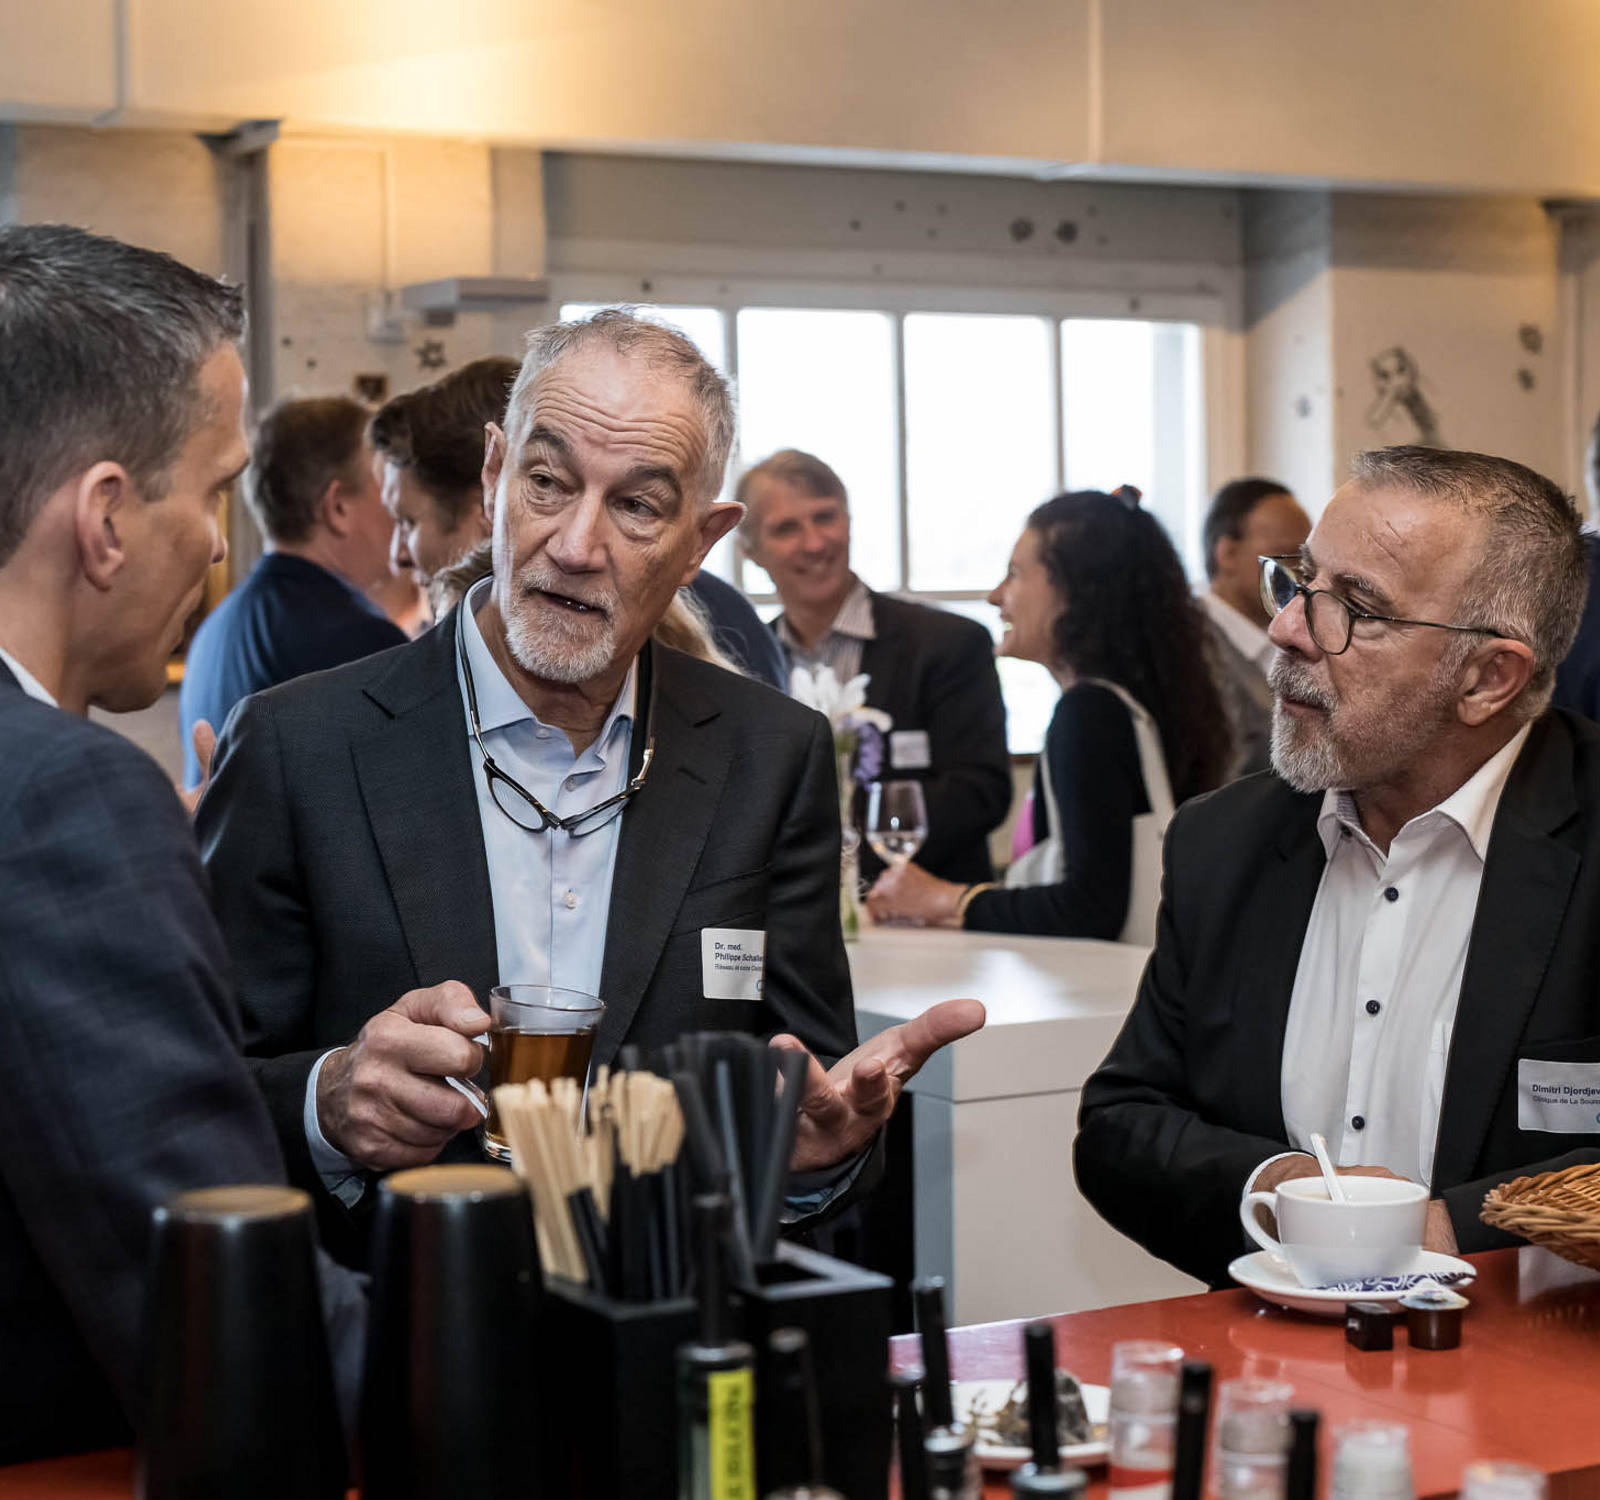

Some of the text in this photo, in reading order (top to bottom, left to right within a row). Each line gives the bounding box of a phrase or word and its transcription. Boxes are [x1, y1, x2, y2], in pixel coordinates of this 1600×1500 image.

[714, 942, 726, 950] Dr.
[714, 952, 740, 962] Philippe
[1532, 1084, 1560, 1094] Dimitri
